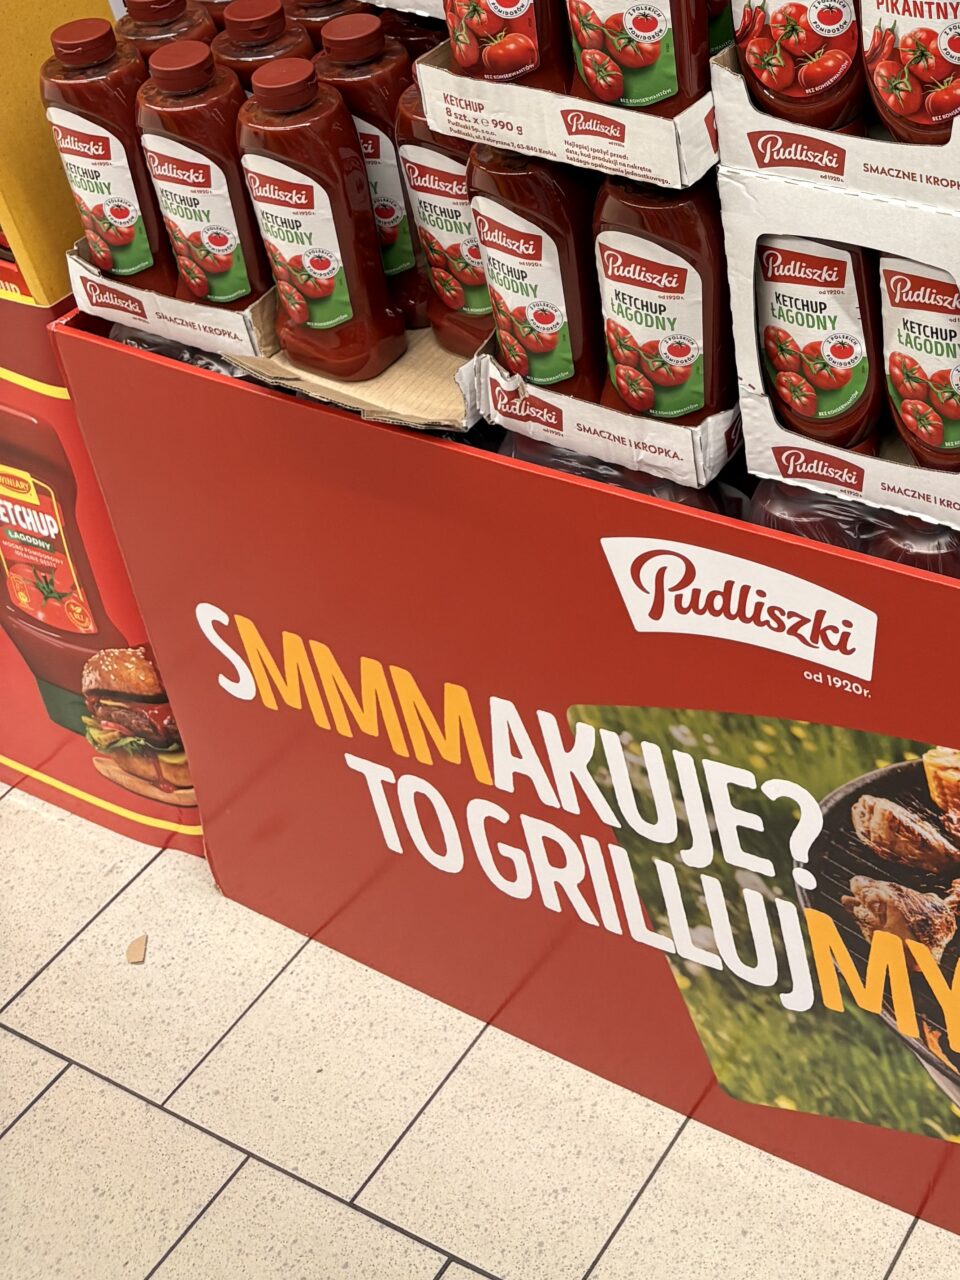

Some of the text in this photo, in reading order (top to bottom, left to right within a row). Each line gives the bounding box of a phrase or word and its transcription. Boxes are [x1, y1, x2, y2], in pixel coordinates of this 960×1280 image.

[443, 93, 484, 113] KETCHUP
[446, 107, 452, 116] 8
[454, 111, 471, 123] szt.
[491, 119, 513, 131] 990
[516, 126, 523, 135] g
[567, 112, 621, 137] Pudliszki
[757, 134, 838, 168] Pudliszki
[863, 163, 917, 182] SMACZNE
[920, 174, 923, 183] I
[250, 174, 308, 205] Pudliszki
[604, 251, 679, 288] Pudliszki
[763, 250, 838, 283] Pudliszki
[88, 279, 142, 315] Pudliszki
[614, 289, 667, 315] KETCHUP
[774, 292, 827, 314] KETCHUP
[611, 299, 677, 332] ŁAGODNY
[770, 302, 838, 331] ŁAGODNY
[630, 549, 856, 656] Pudliszki
[803, 670, 823, 684] od
[194, 601, 824, 892] SMMMAKUJE?
[344, 752, 466, 876] TO
